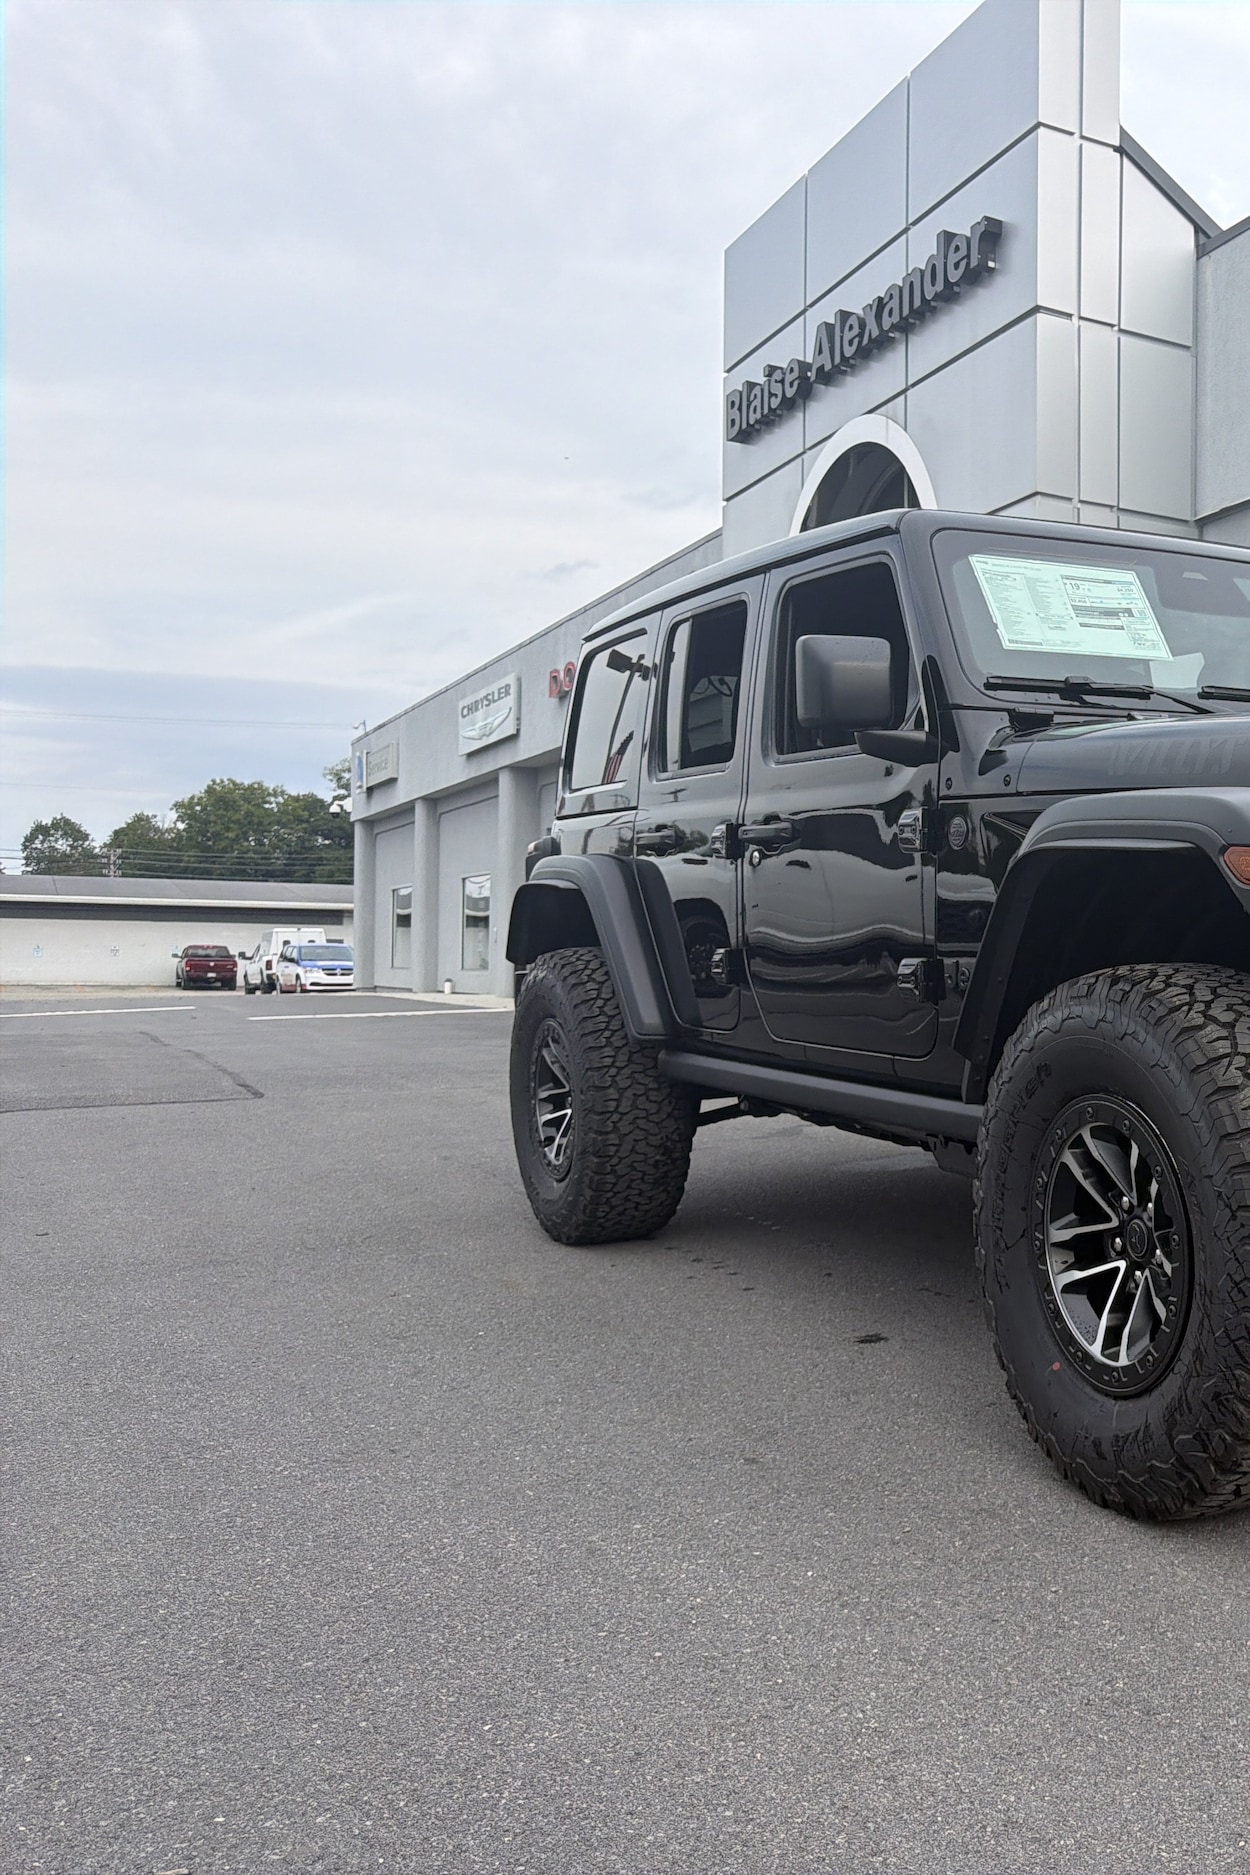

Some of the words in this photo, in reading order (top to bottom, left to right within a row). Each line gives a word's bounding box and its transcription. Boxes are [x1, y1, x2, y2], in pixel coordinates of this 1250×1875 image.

[726, 359, 807, 442] Blaise
[811, 216, 1003, 384] Alexander
[461, 683, 511, 719] CHRYSLER
